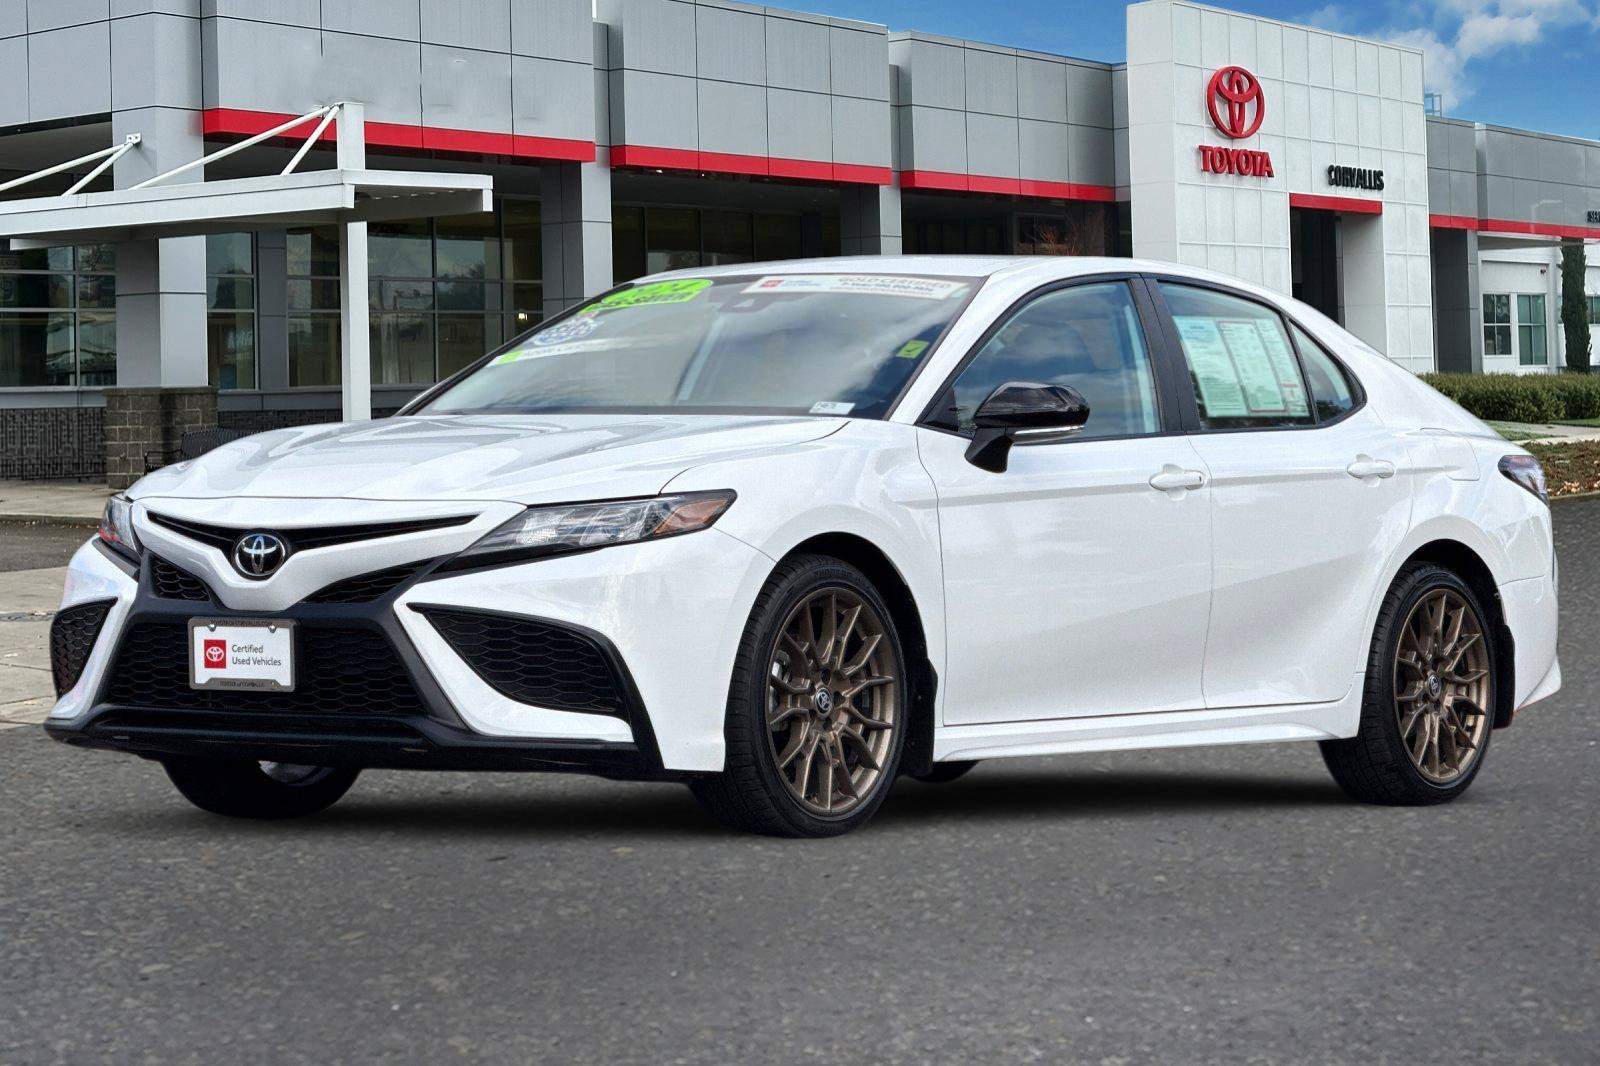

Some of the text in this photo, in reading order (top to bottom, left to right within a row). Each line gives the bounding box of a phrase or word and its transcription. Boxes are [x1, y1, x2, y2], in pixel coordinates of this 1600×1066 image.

[1198, 144, 1275, 178] TOYOTA
[1327, 164, 1385, 191] CORVALLIS
[231, 644, 264, 654] Certified
[231, 658, 282, 667] Used Vehicles
